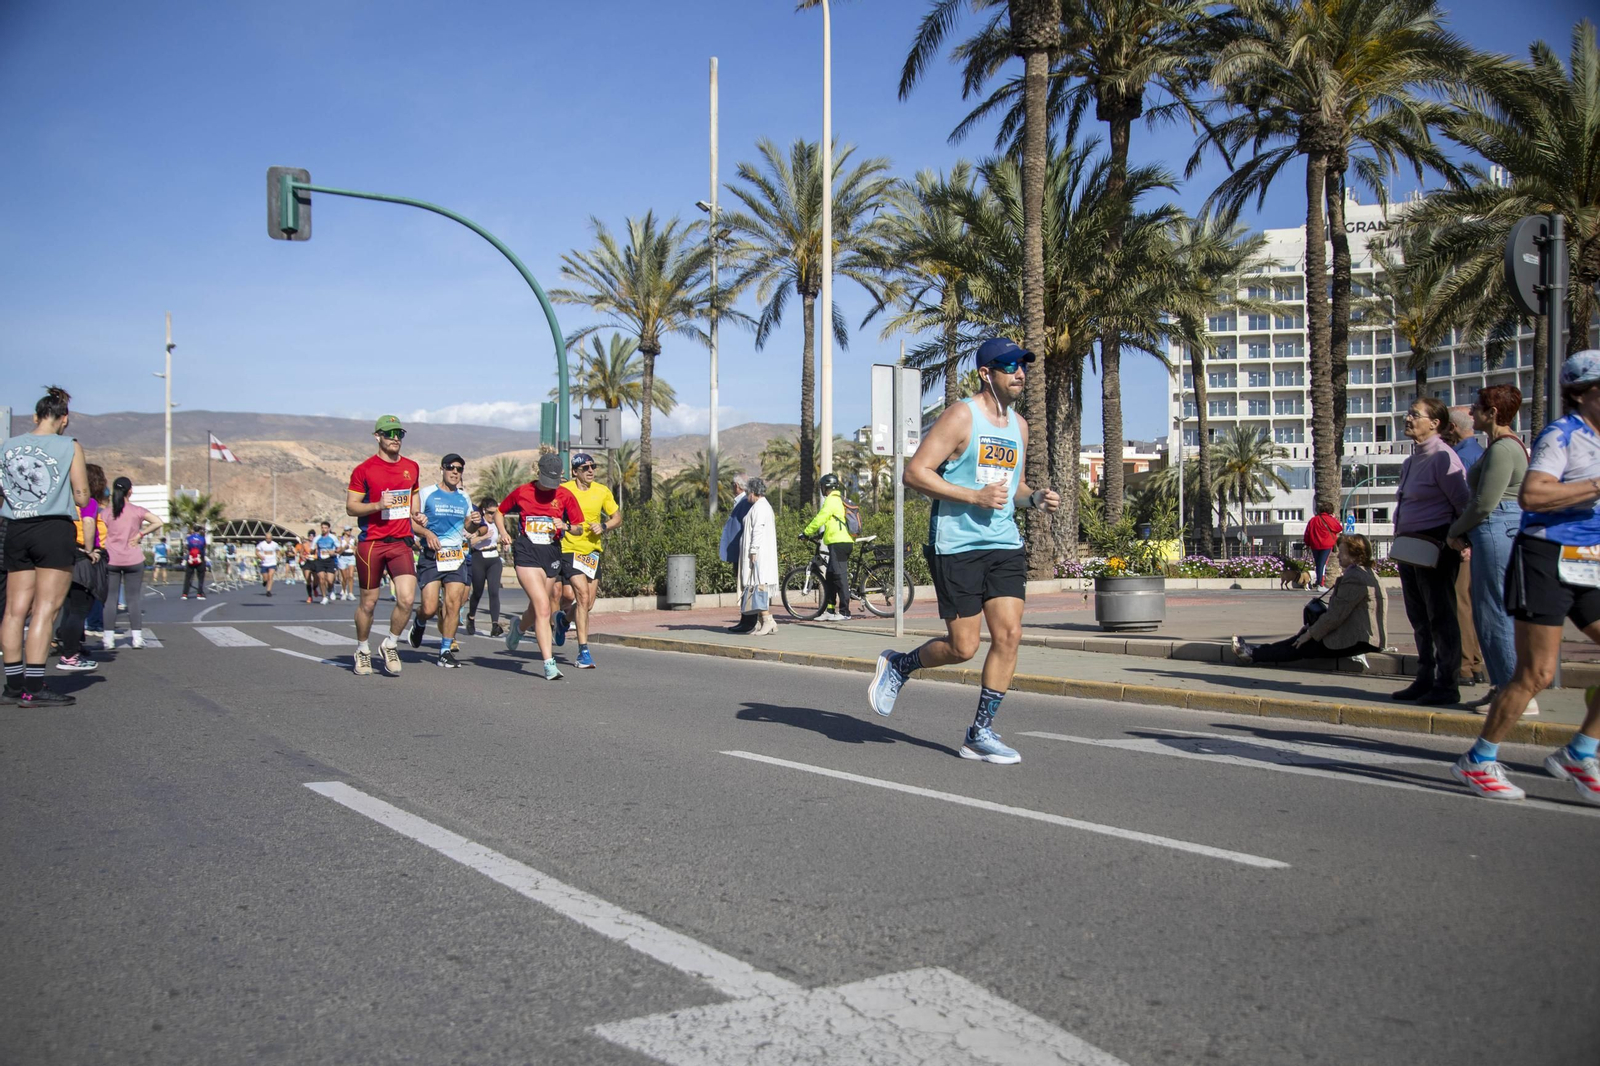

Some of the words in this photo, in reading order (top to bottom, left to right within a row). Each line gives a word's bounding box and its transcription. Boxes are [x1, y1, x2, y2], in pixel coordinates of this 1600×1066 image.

[1345, 221, 1390, 234] GRAN
[530, 521, 554, 530] 1729
[440, 549, 461, 559] 2037
